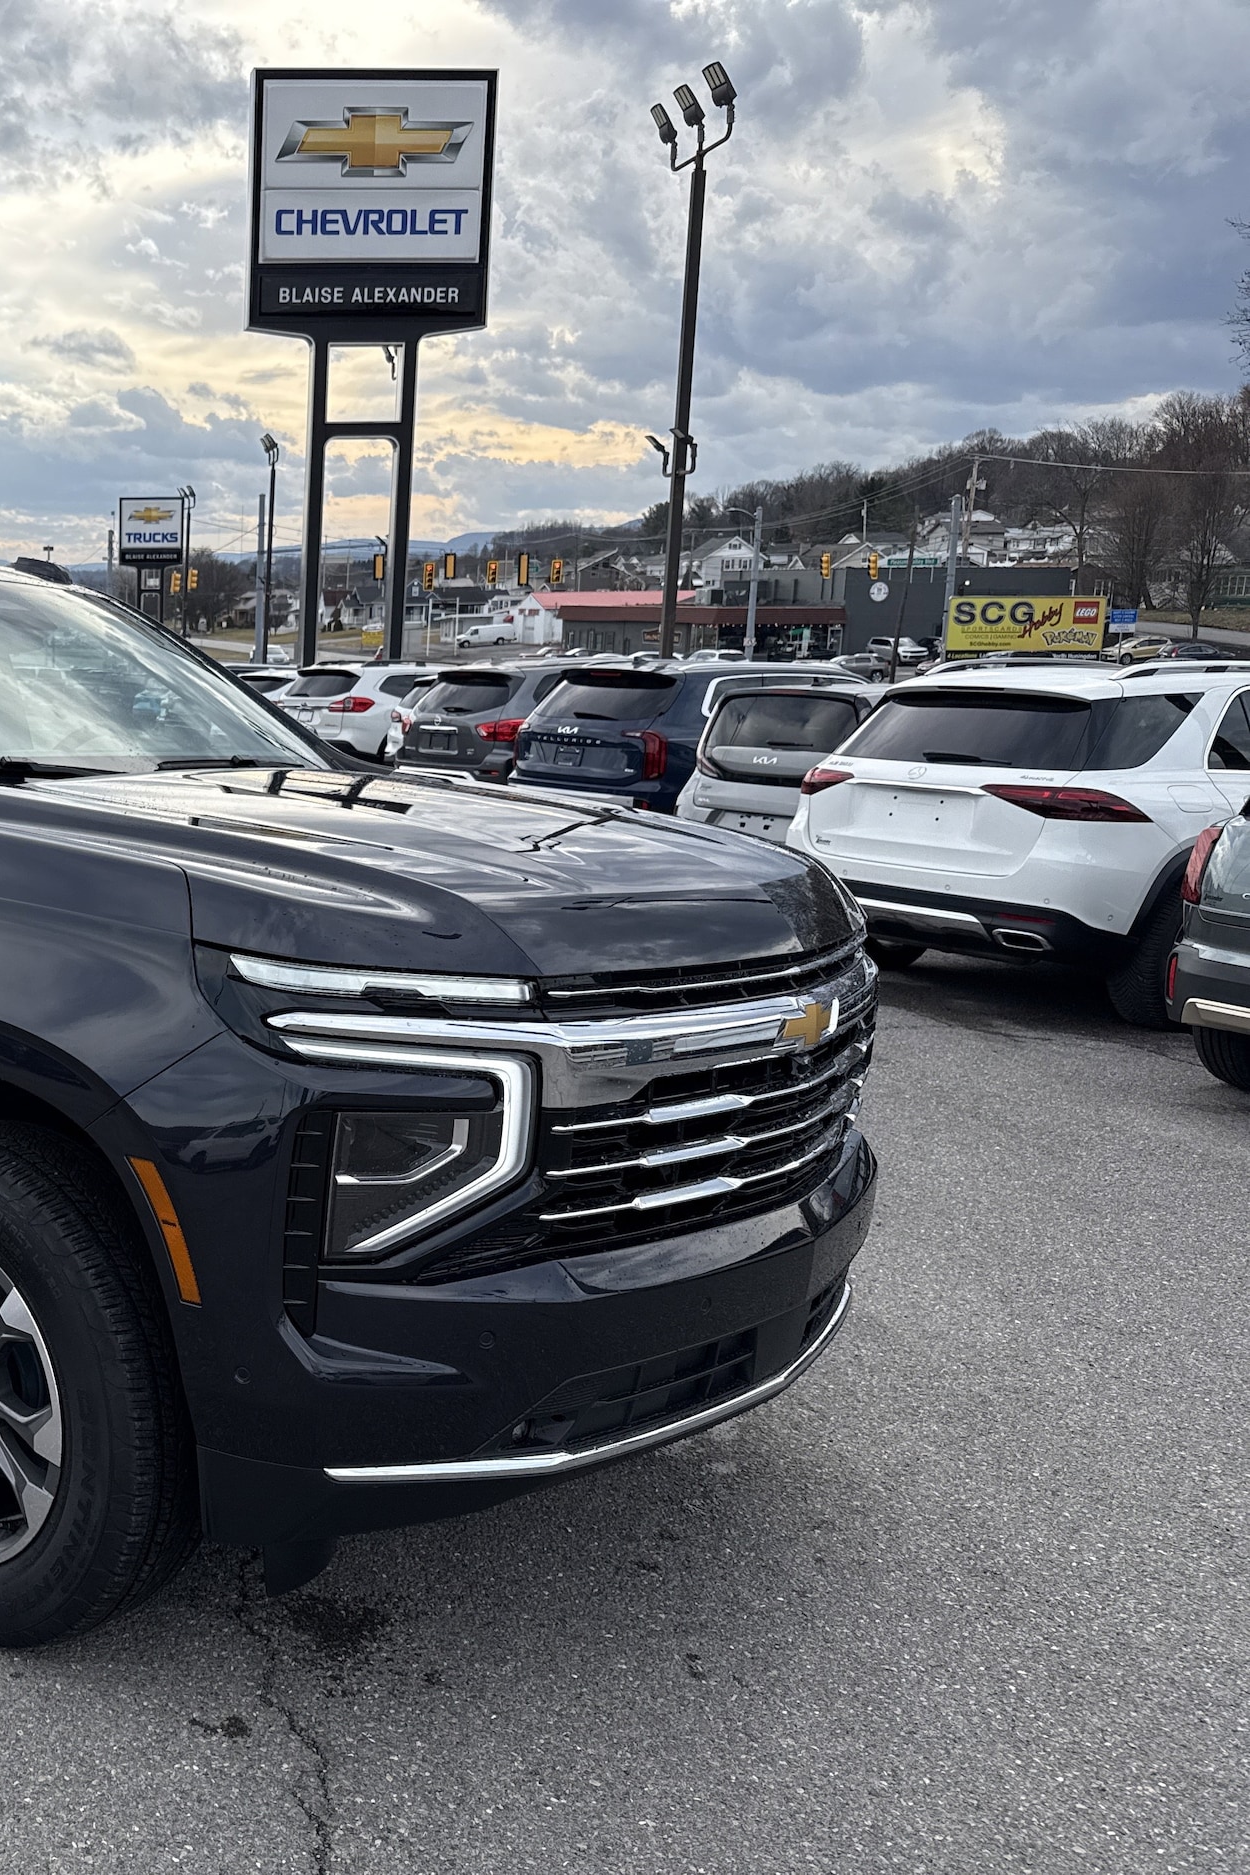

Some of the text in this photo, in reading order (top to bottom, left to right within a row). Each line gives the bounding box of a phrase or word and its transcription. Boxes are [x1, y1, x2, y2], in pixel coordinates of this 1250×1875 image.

[275, 209, 469, 236] CHEVROLET
[278, 287, 460, 304] BLAISE ALEXANDER
[125, 532, 179, 543] TRUCKS
[953, 601, 1035, 626] SCG
[1075, 607, 1097, 617] LEGO
[1017, 602, 1064, 638] Hobby
[557, 726, 579, 734] KIA
[537, 735, 601, 744] TELLURIDE
[752, 756, 777, 765] KIA
